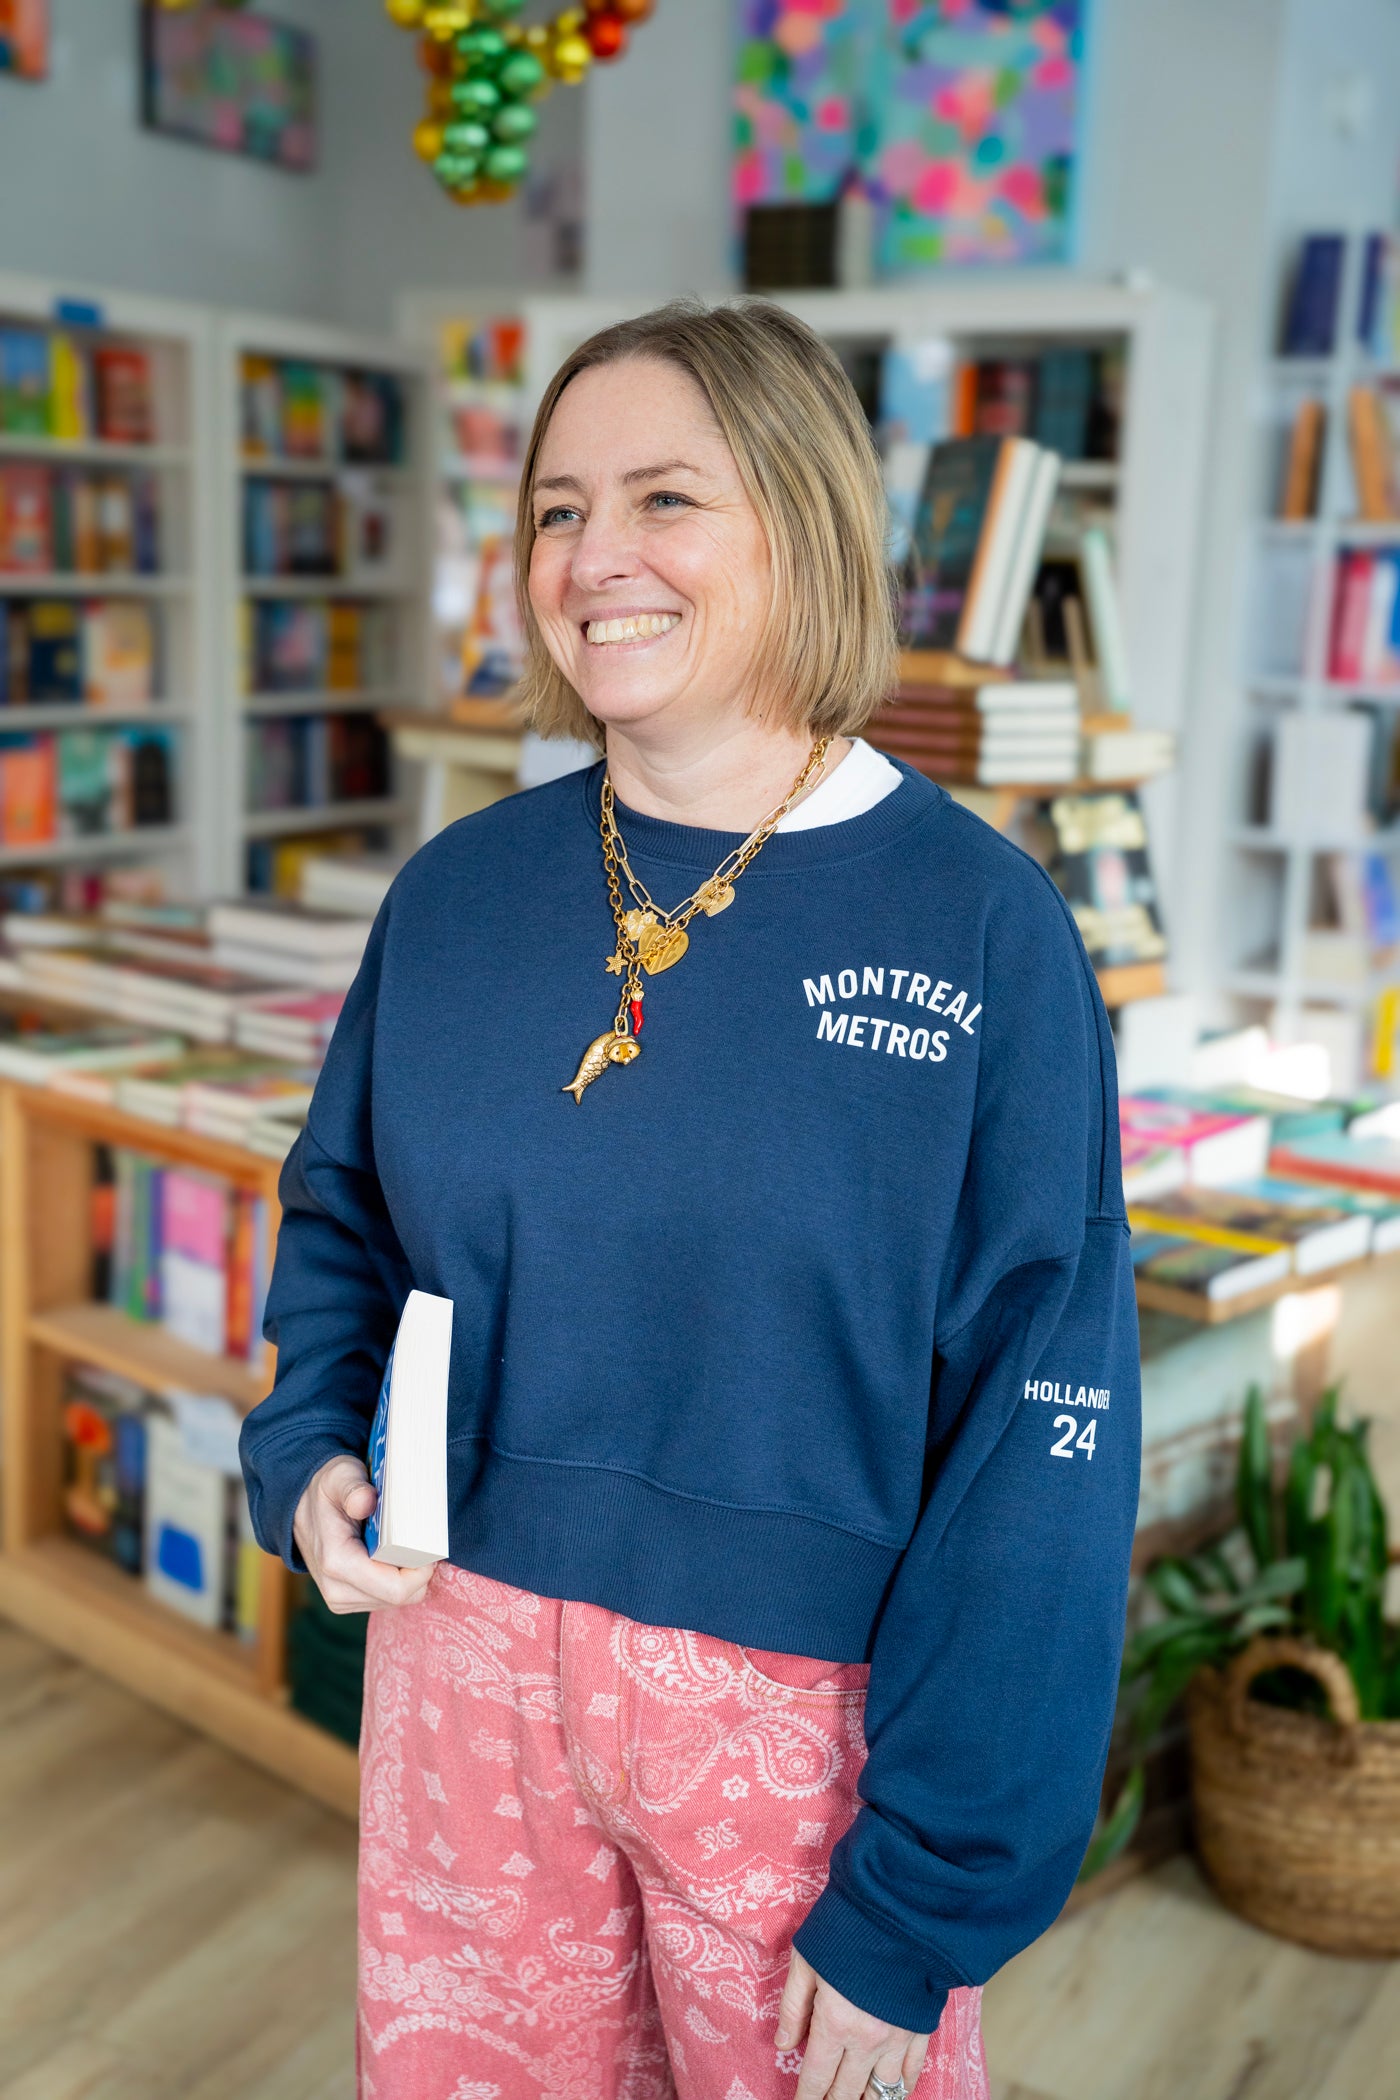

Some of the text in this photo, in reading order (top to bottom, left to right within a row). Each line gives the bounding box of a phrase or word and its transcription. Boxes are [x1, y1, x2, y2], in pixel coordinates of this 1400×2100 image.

[802, 966, 983, 1036] MONTREAL
[816, 1010, 950, 1062] METROS
[1050, 1414, 1097, 1461] 24
